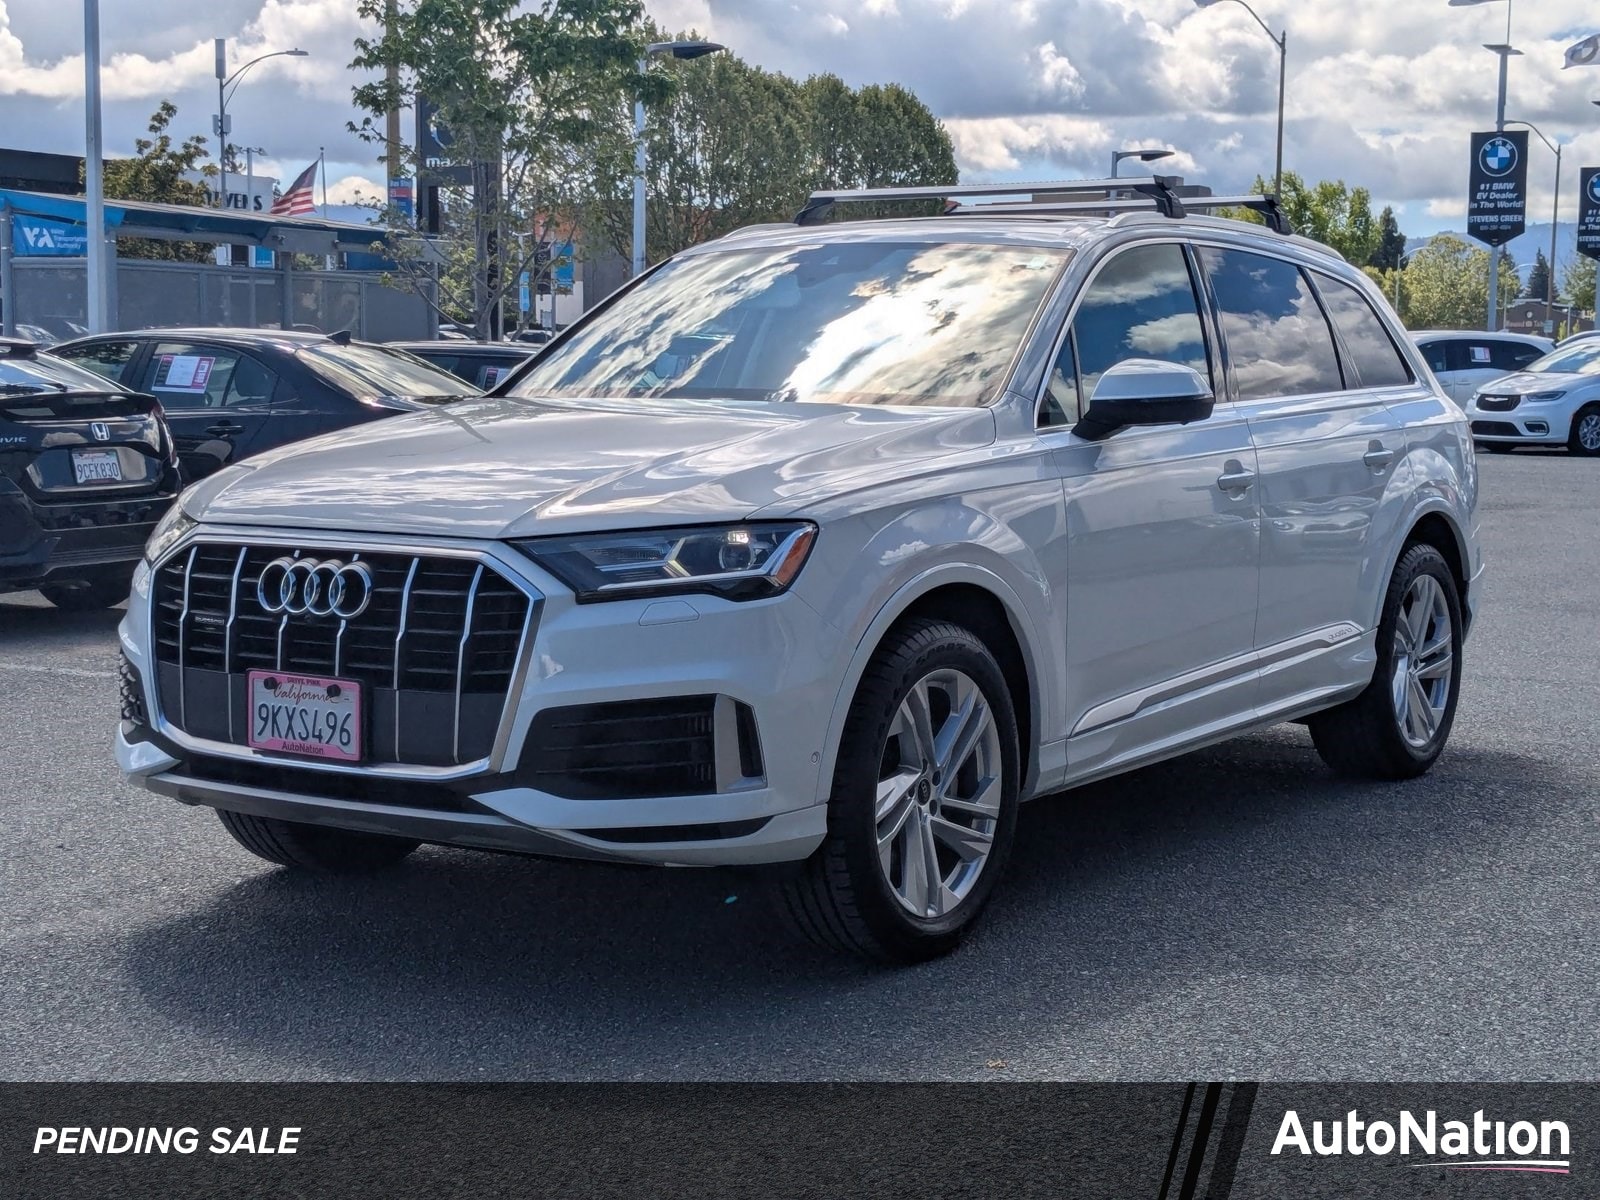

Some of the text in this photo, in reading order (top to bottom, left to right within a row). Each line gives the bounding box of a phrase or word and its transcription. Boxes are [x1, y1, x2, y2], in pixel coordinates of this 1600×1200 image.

[1492, 182, 1516, 190] BMW
[1476, 191, 1518, 200] EV Dealer
[1480, 201, 1495, 209] The
[1469, 214, 1523, 223] STEVENS CREEK
[76, 462, 119, 481] 9CFK830
[257, 703, 351, 747] 9KXS496
[281, 741, 324, 755] AutoNation
